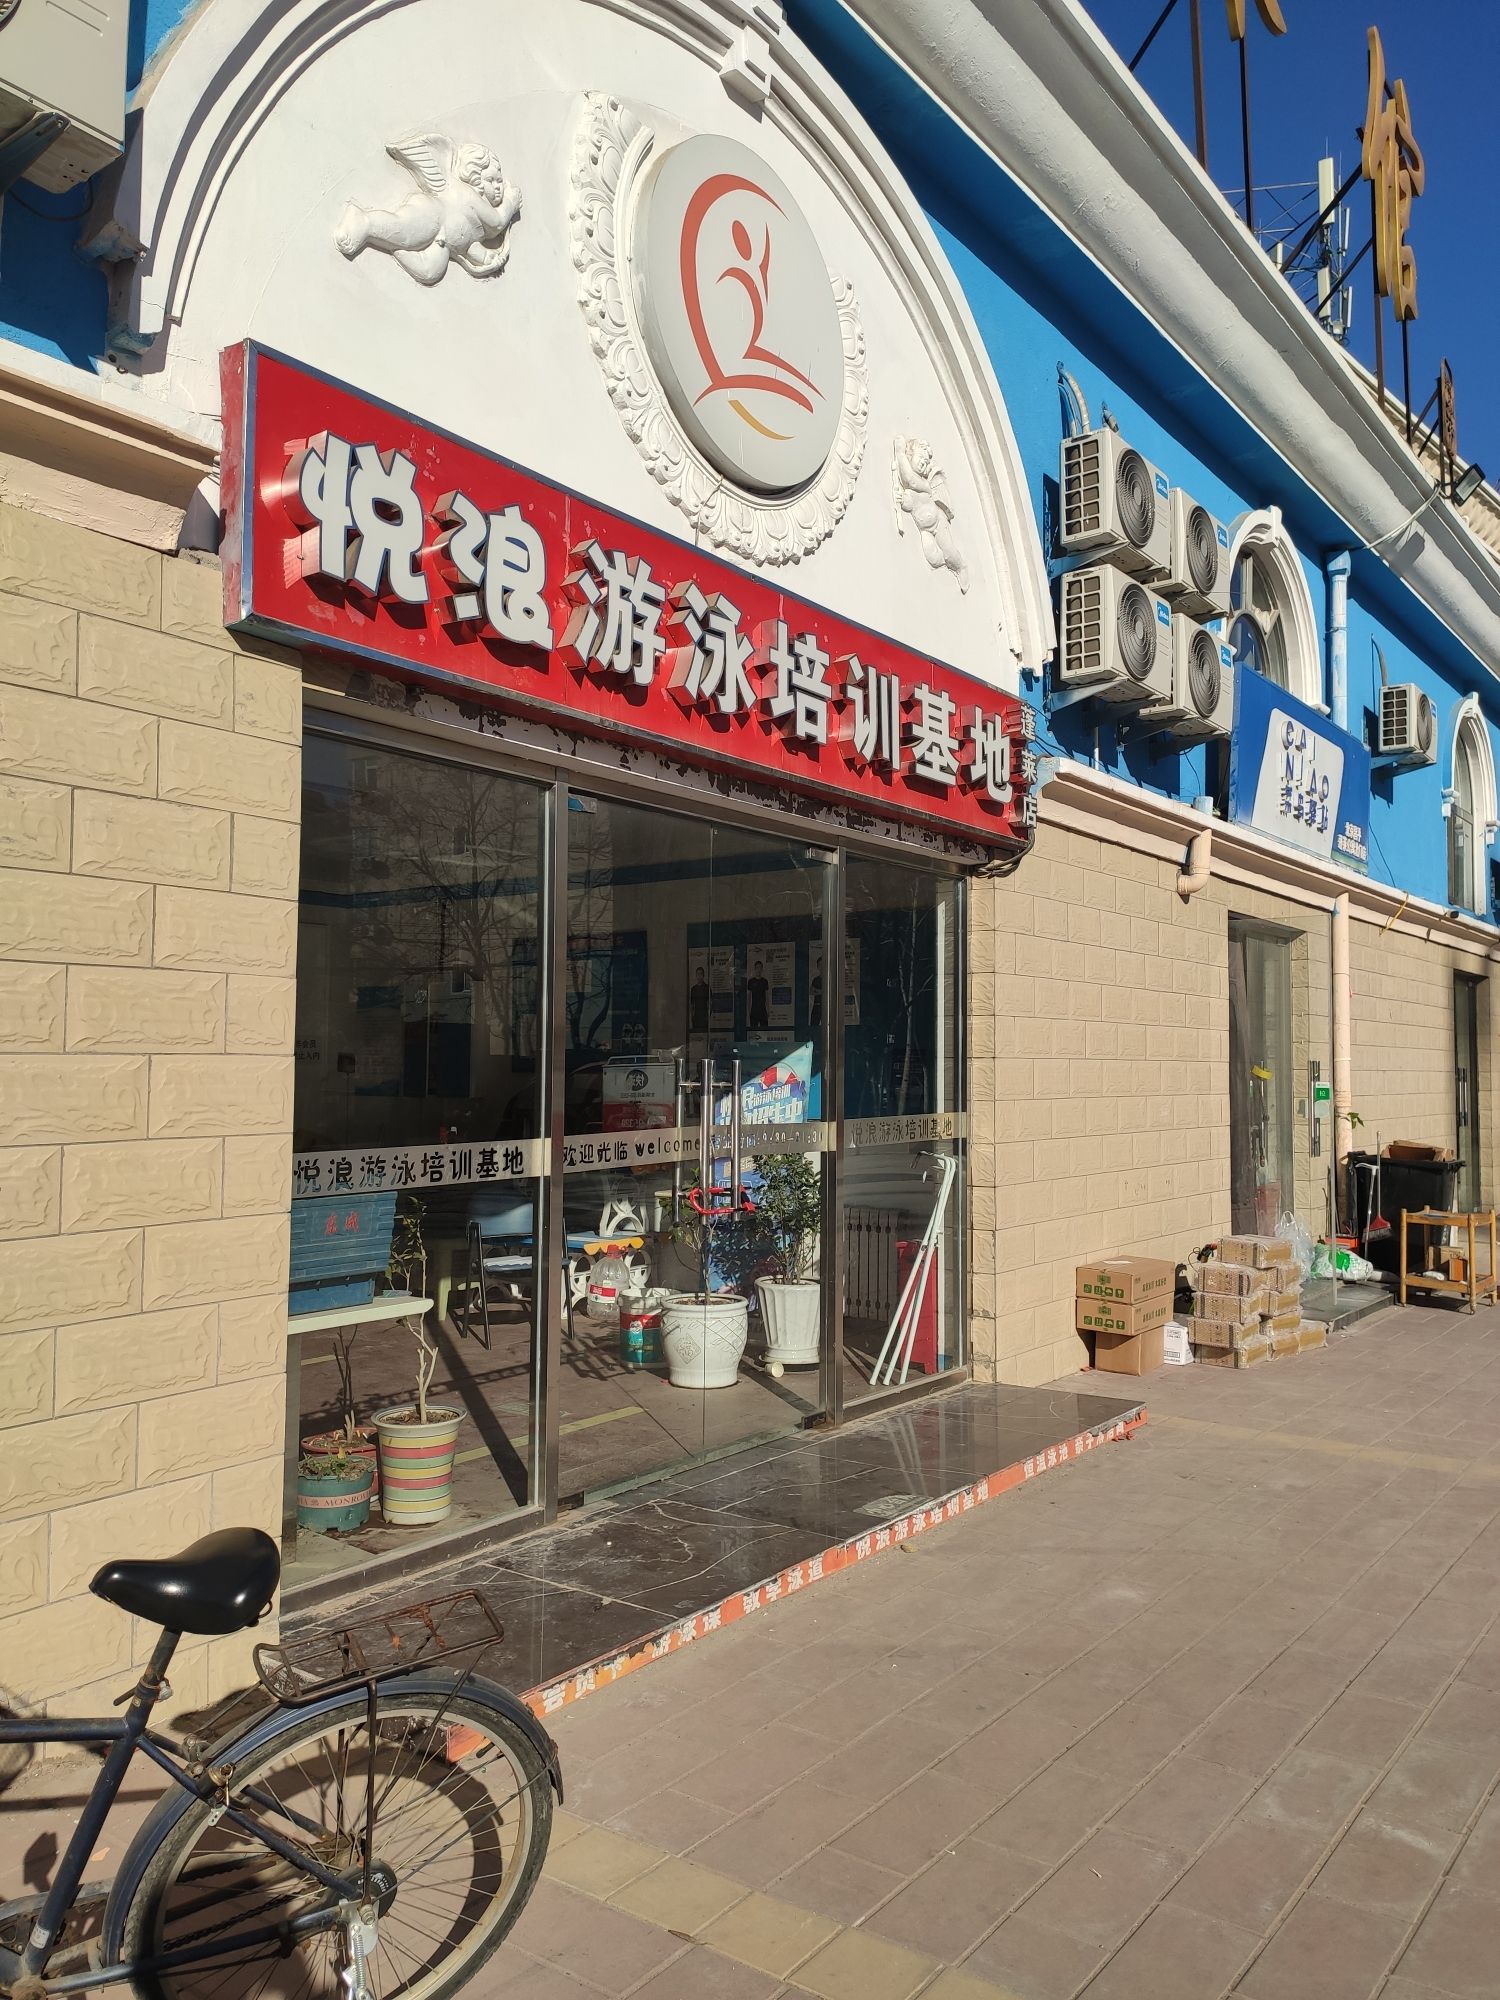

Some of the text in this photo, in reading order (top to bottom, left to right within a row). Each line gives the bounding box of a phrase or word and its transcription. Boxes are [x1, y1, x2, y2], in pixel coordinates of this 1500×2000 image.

[300, 432, 1013, 803] 悦浪游泳培训基地
[1020, 703, 1037, 829] 蓬莱店
[1284, 751, 1329, 799] NIAO
[563, 1136, 700, 1167] 欢迎光临 welcome
[851, 1116, 953, 1145] 悦浪游泳培训基地
[294, 1146, 524, 1195] 悦浪游泳培训基地
